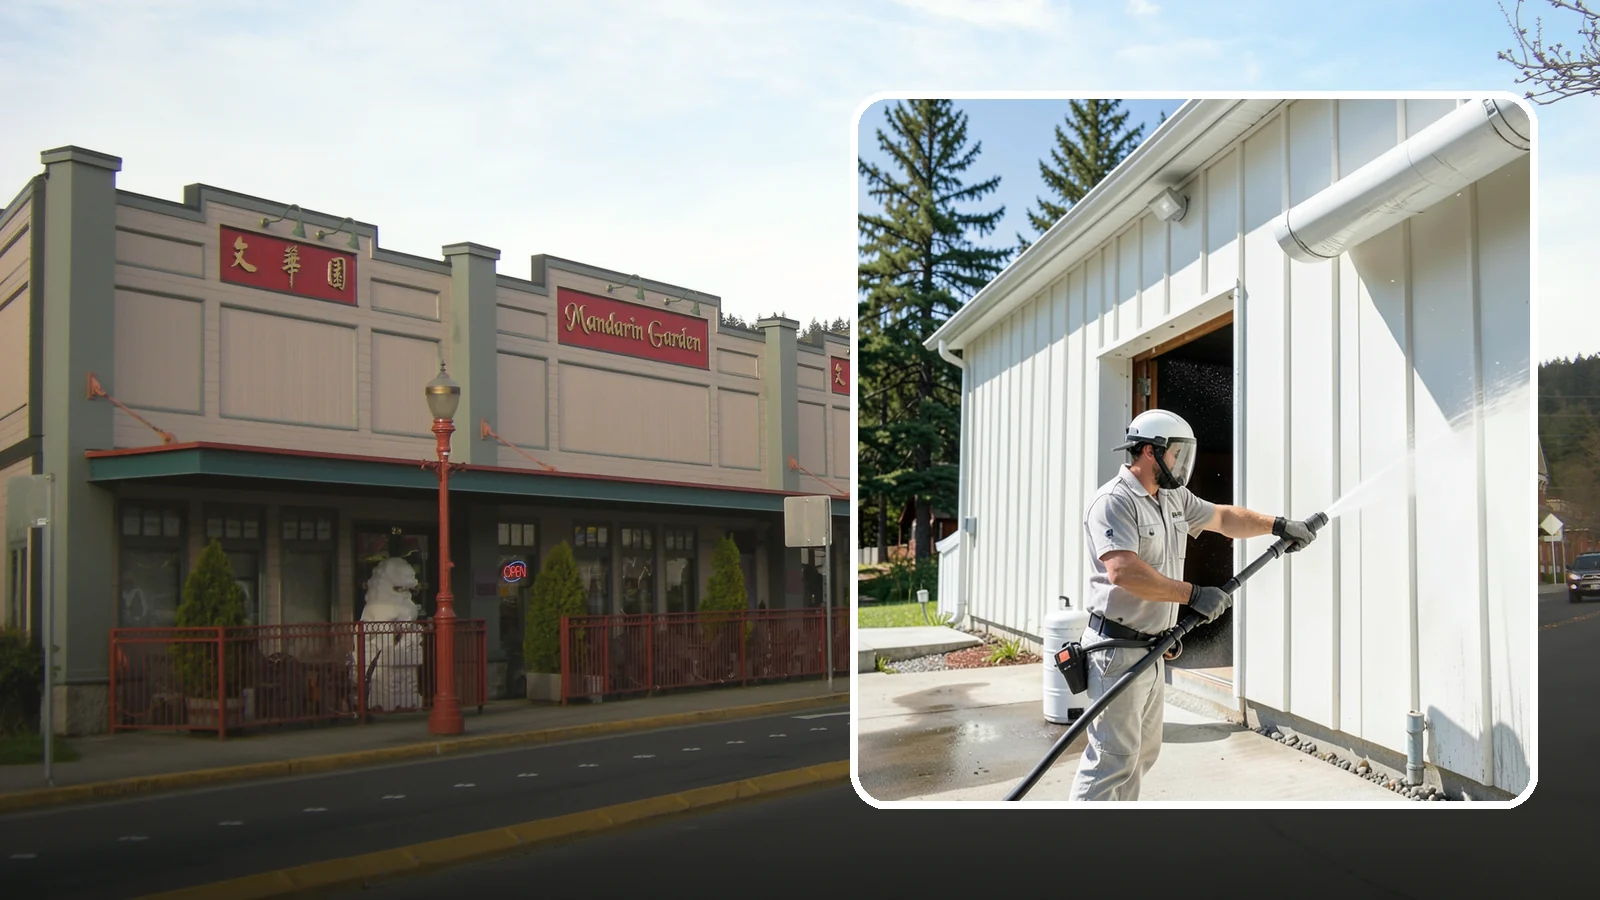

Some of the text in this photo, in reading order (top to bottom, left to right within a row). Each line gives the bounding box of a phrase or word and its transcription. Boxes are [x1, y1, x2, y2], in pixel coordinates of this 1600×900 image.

[230, 235, 345, 291] 文華園
[564, 302, 701, 352] Mandarin Garden
[834, 362, 847, 386] 文
[503, 565, 527, 578] OPEN
